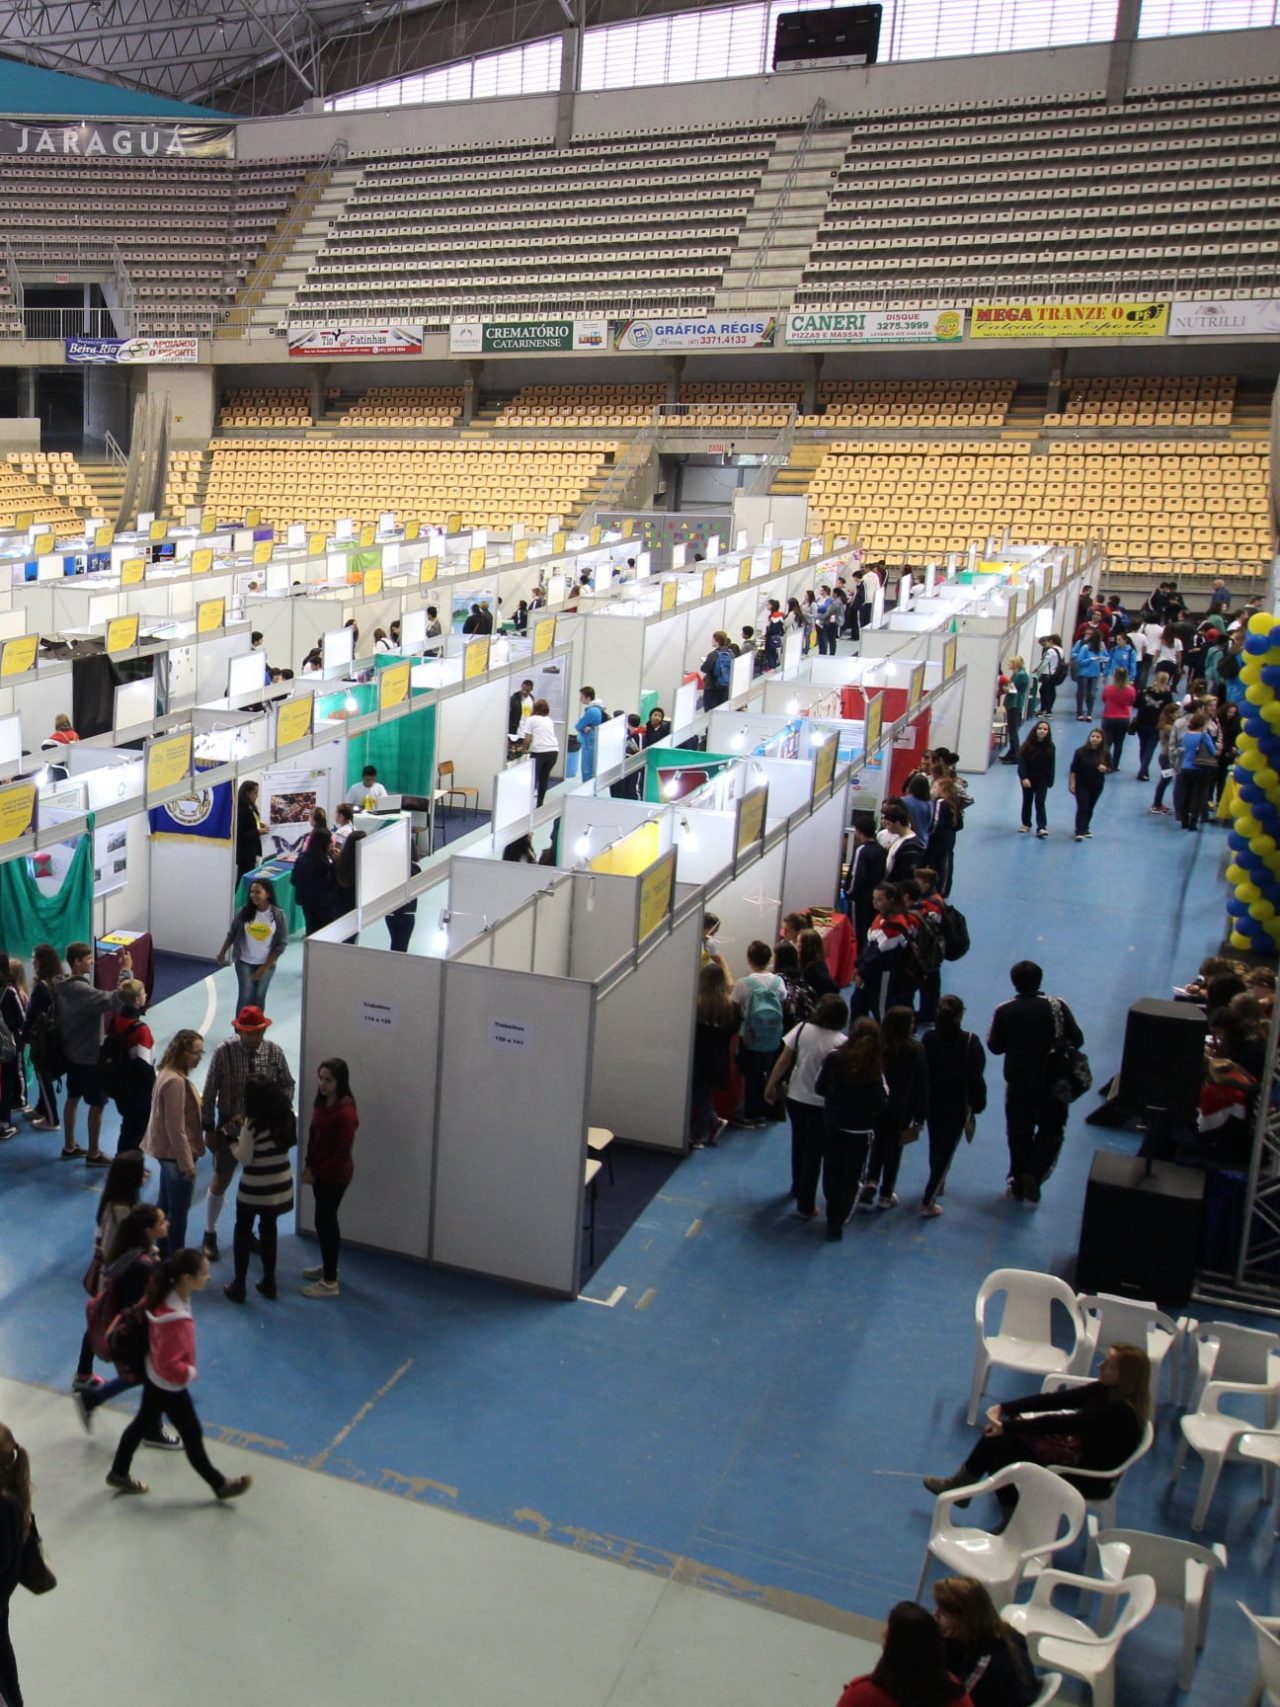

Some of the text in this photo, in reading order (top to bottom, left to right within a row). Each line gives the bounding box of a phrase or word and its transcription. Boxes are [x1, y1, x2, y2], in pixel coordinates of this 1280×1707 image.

[886, 313, 921, 321] DISQUE
[976, 308, 1033, 322] MEGA
[1037, 307, 1107, 321] TRANZE
[792, 314, 867, 331] CANERI
[876, 321, 929, 331] 3275.3999
[1080, 322, 1157, 331] Esportes
[1176, 315, 1246, 328] NUTRILLI
[486, 323, 569, 339] CREMATÓRIO
[655, 321, 764, 335] GRÁFICA RÉGIS
[153, 340, 197, 348] APOIANDO
[321, 335, 387, 346] Tio Patinhas
[493, 338, 562, 349] CATARINENSE
[700, 335, 747, 345] 3371.4133
[69, 343, 117, 354] Beira Rio
